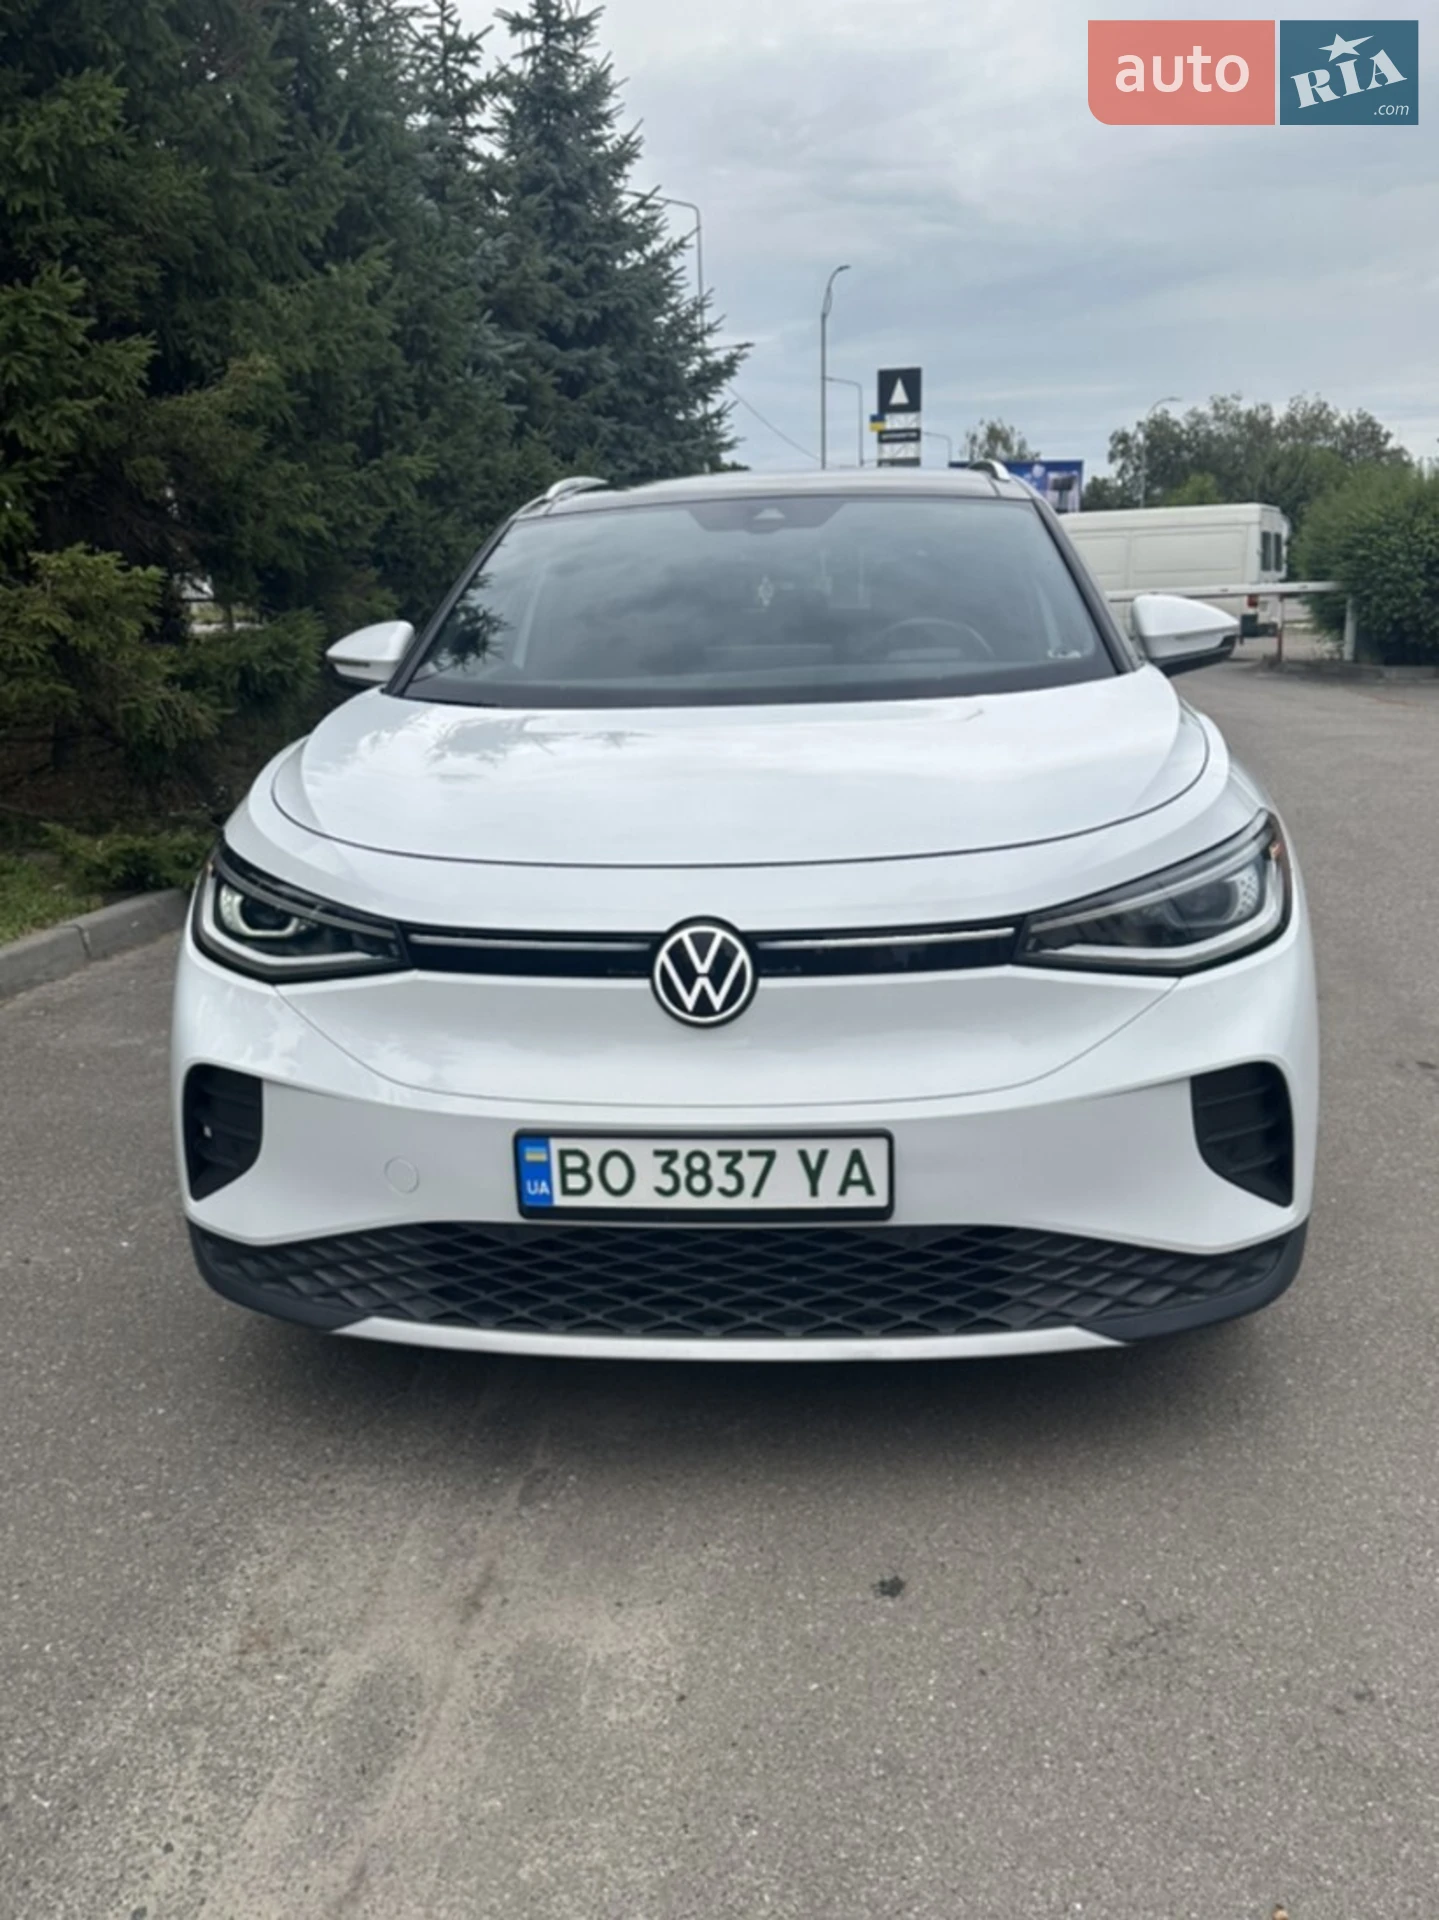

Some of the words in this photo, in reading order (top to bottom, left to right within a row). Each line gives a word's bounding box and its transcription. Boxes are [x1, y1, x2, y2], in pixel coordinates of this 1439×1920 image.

[660, 929, 746, 1013] VW
[526, 1181, 550, 1195] UA
[557, 1148, 636, 1197] BO
[652, 1149, 777, 1198] 3837
[798, 1148, 876, 1198] YA
